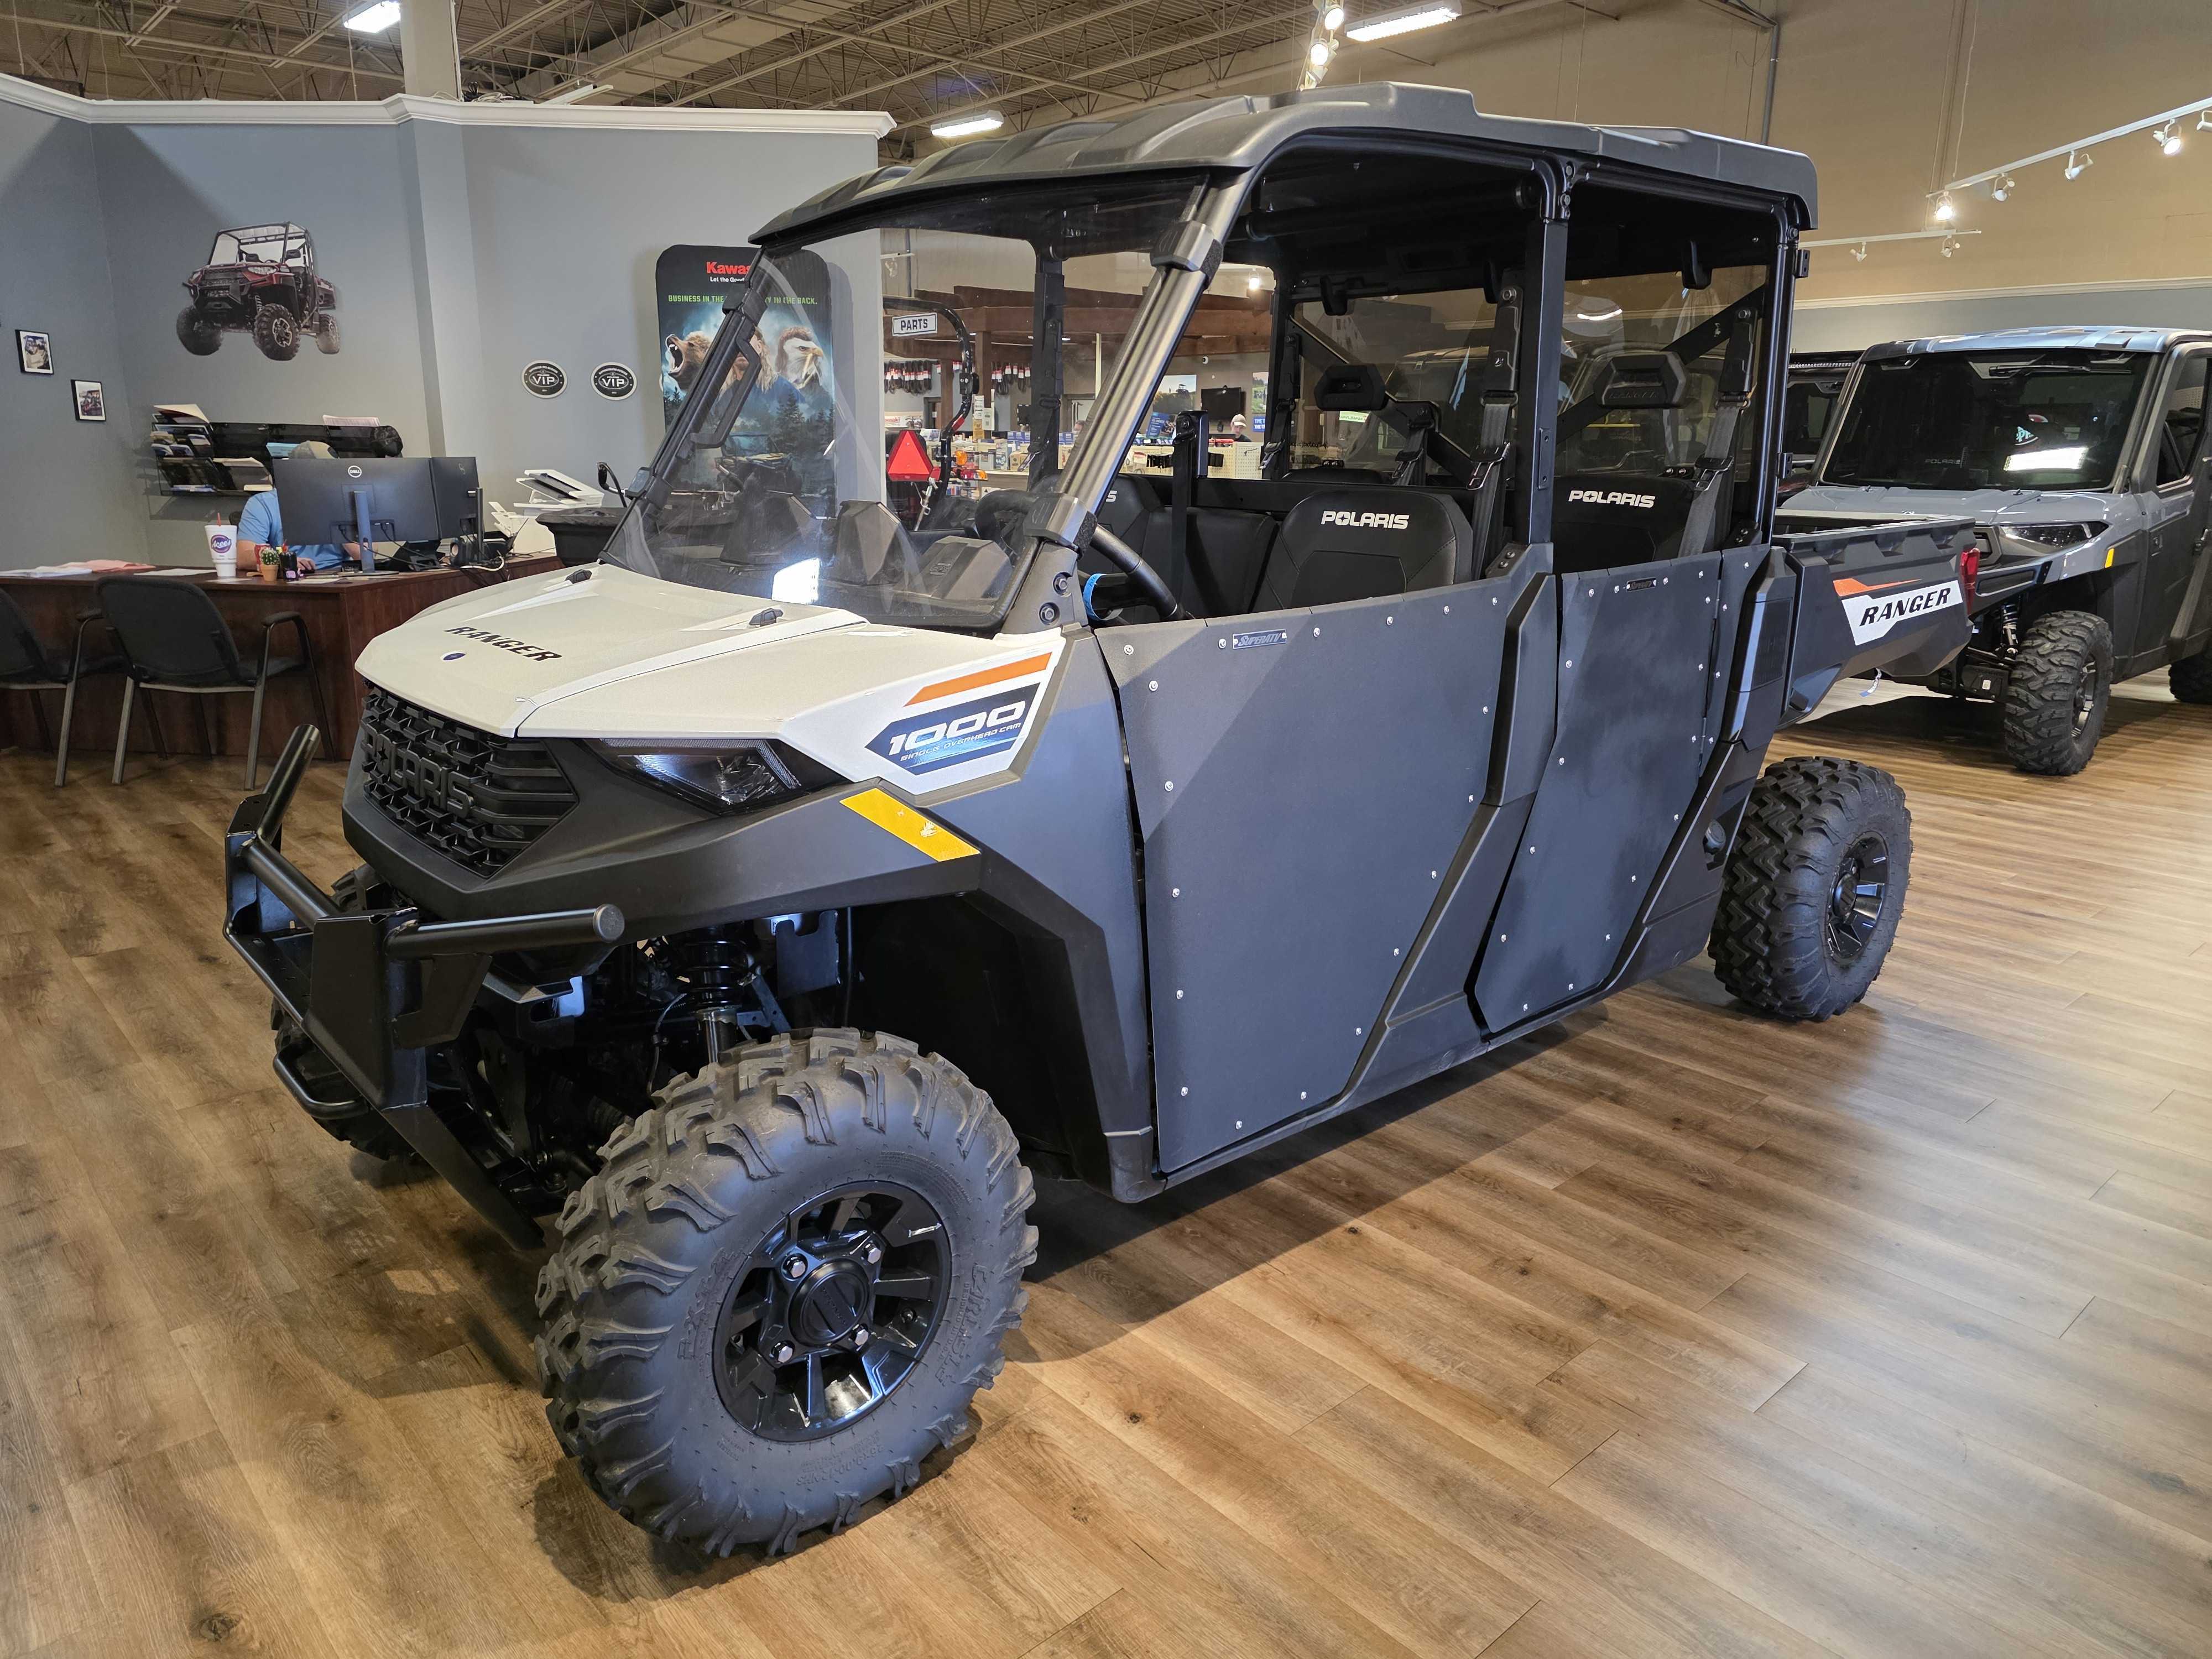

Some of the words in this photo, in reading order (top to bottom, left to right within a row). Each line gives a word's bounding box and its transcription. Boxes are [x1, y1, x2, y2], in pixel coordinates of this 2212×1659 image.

[900, 319, 928, 331] PARTS
[533, 375, 555, 385] VIP
[602, 378, 625, 387] VIP
[1568, 490, 1656, 508] POLARIS
[1321, 510, 1410, 530] POLARIS
[1859, 587, 1952, 627] RANGER
[444, 626, 562, 662] RANGER
[888, 700, 1026, 756] 1000
[900, 746, 940, 761] SINGLE
[943, 729, 999, 749] OVERHEAD
[999, 722, 1021, 733] CAM
[361, 722, 471, 820] POLARIS
